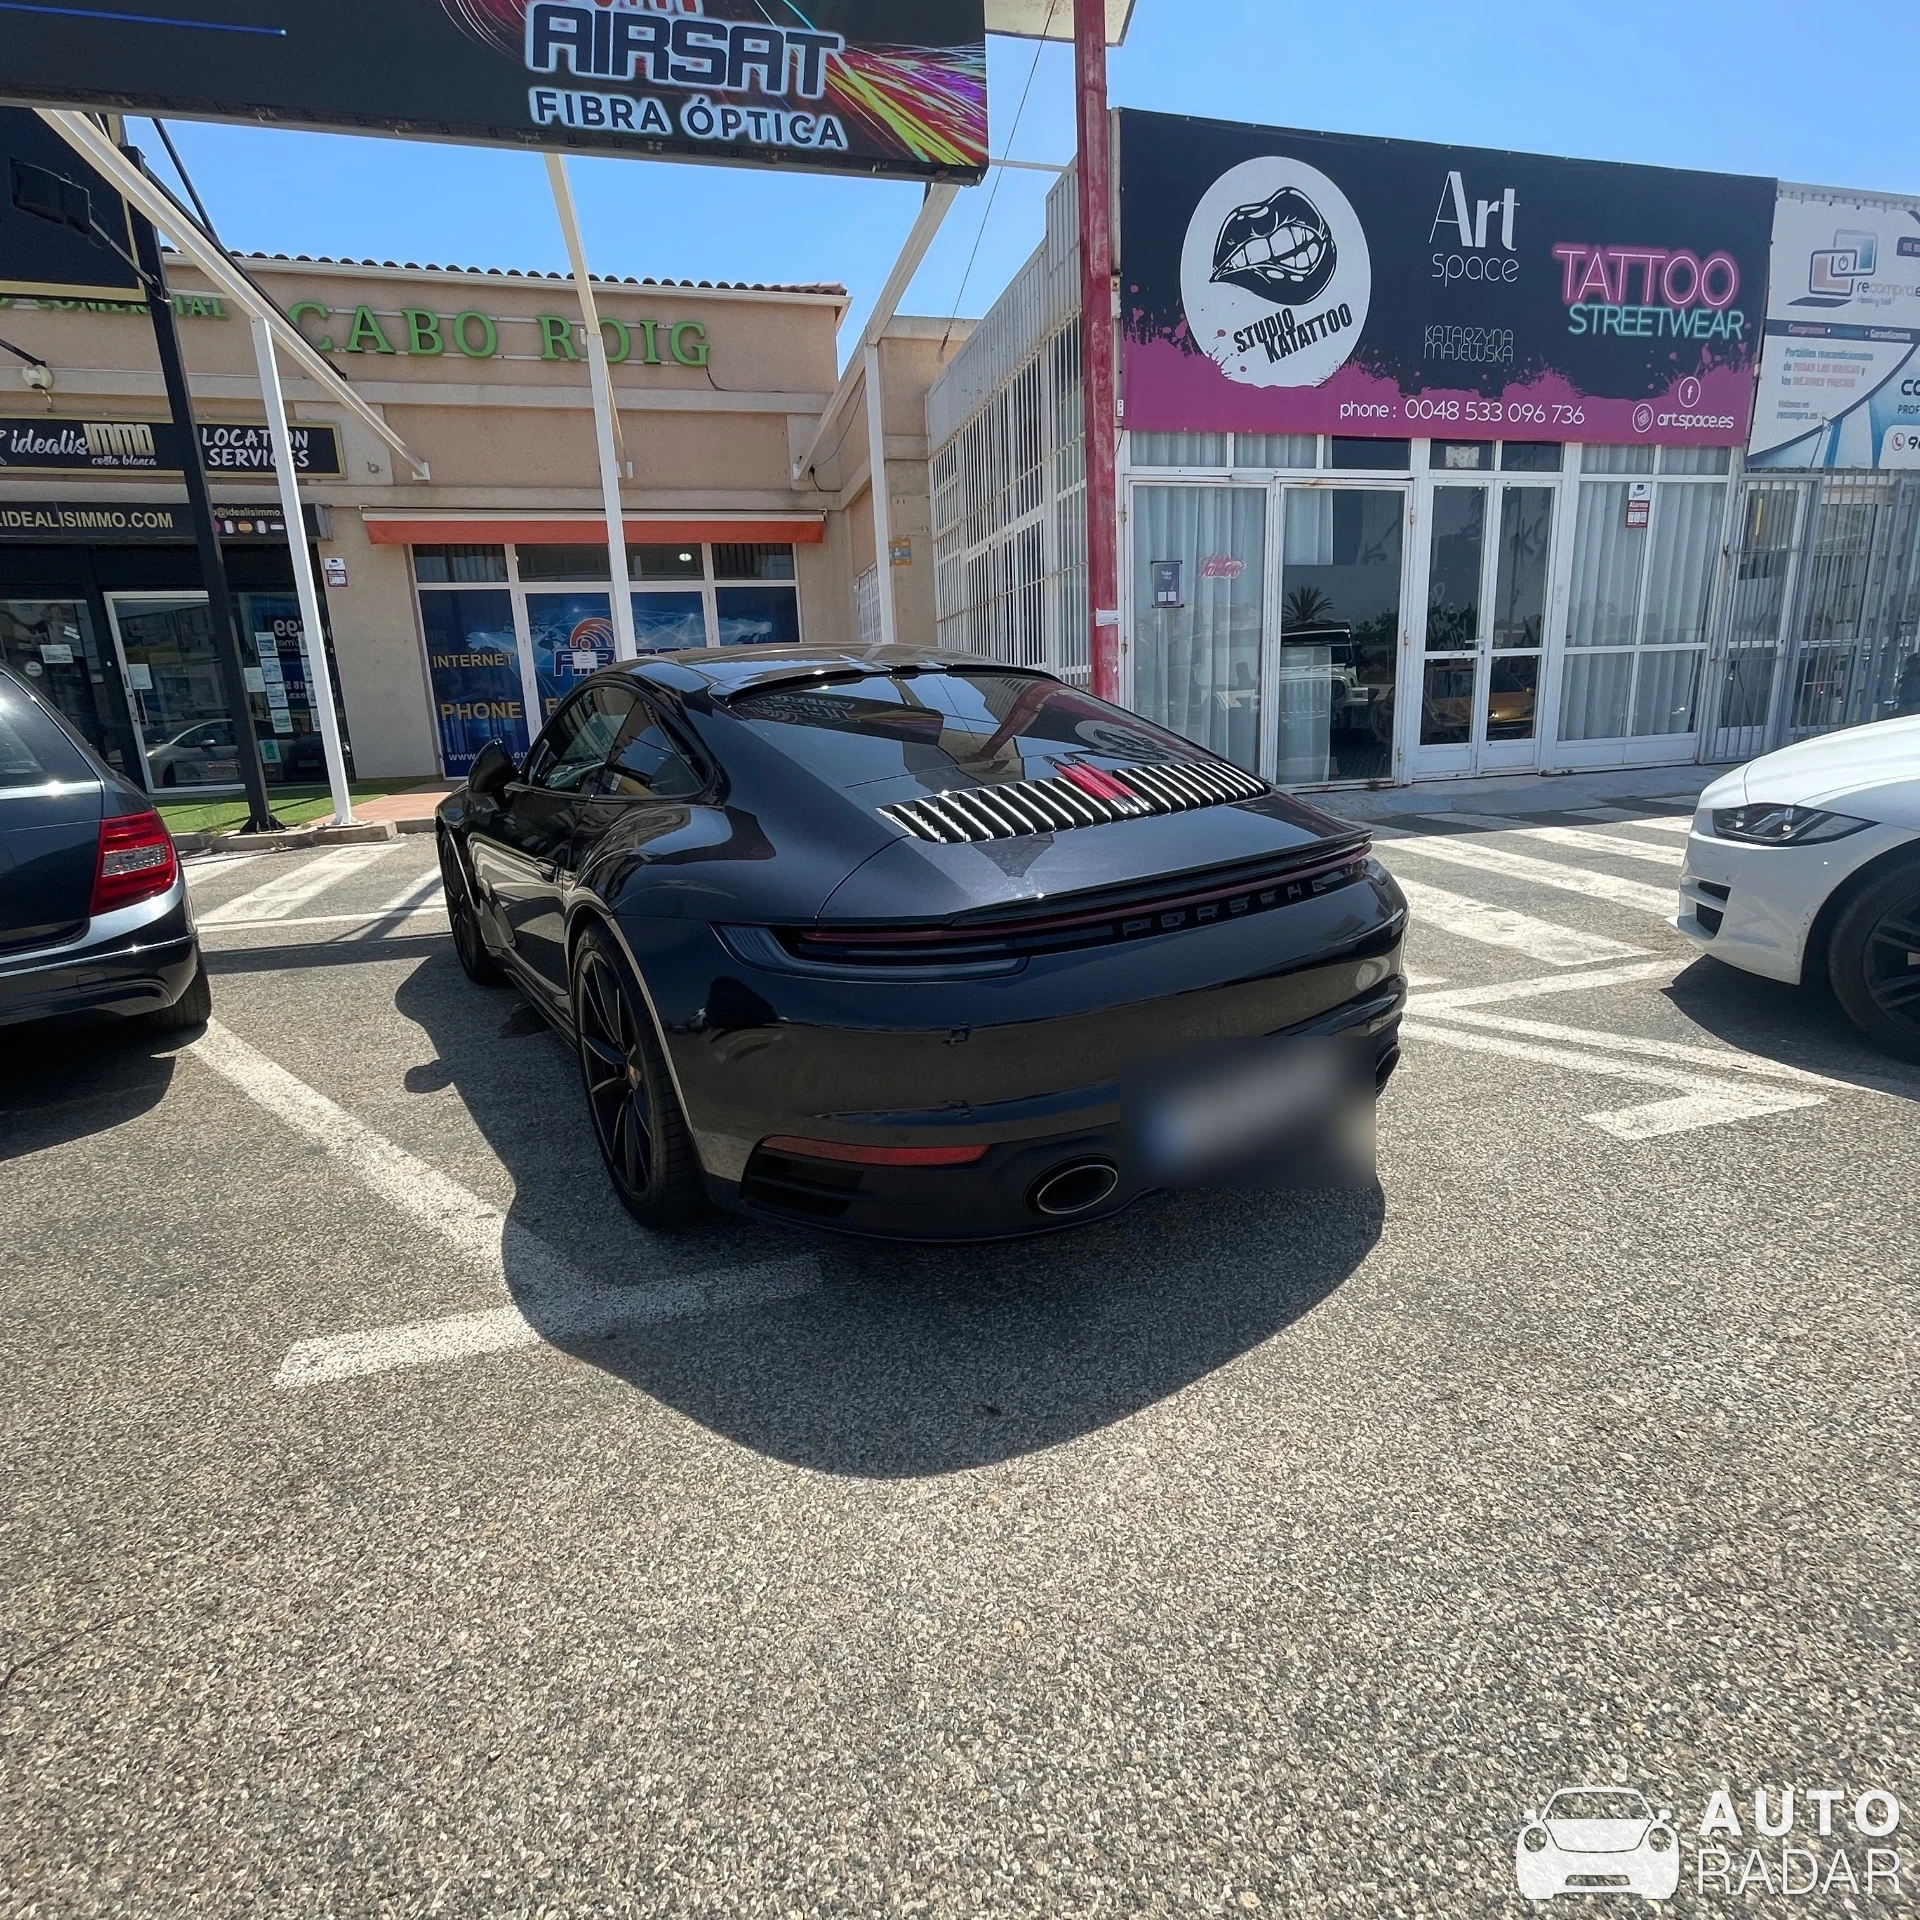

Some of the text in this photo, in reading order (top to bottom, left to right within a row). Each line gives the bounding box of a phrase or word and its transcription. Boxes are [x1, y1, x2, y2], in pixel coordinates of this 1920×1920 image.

[527, 3, 844, 99] AIRSAT
[529, 87, 849, 152] FIBRA ÓPTICA
[1428, 170, 1521, 251] Art
[1431, 253, 1520, 288] space
[1554, 246, 1740, 308] TATTOO
[289, 302, 711, 367] CABO ROIG
[1233, 307, 1296, 353] STUDIO
[1263, 303, 1353, 364] KATATTOO
[1568, 304, 1745, 340] STREETWEAR
[1340, 401, 1390, 420] phone
[1404, 399, 1459, 420] 0048
[1465, 402, 1503, 421] 533
[1507, 403, 1546, 423] 096
[1551, 404, 1585, 425] 736
[202, 428, 309, 448] LOCATN
[91, 455, 157, 466] costa blanca
[208, 448, 310, 468] SERVIS
[432, 653, 514, 669] INTERNET
[440, 701, 524, 721] PHONE
